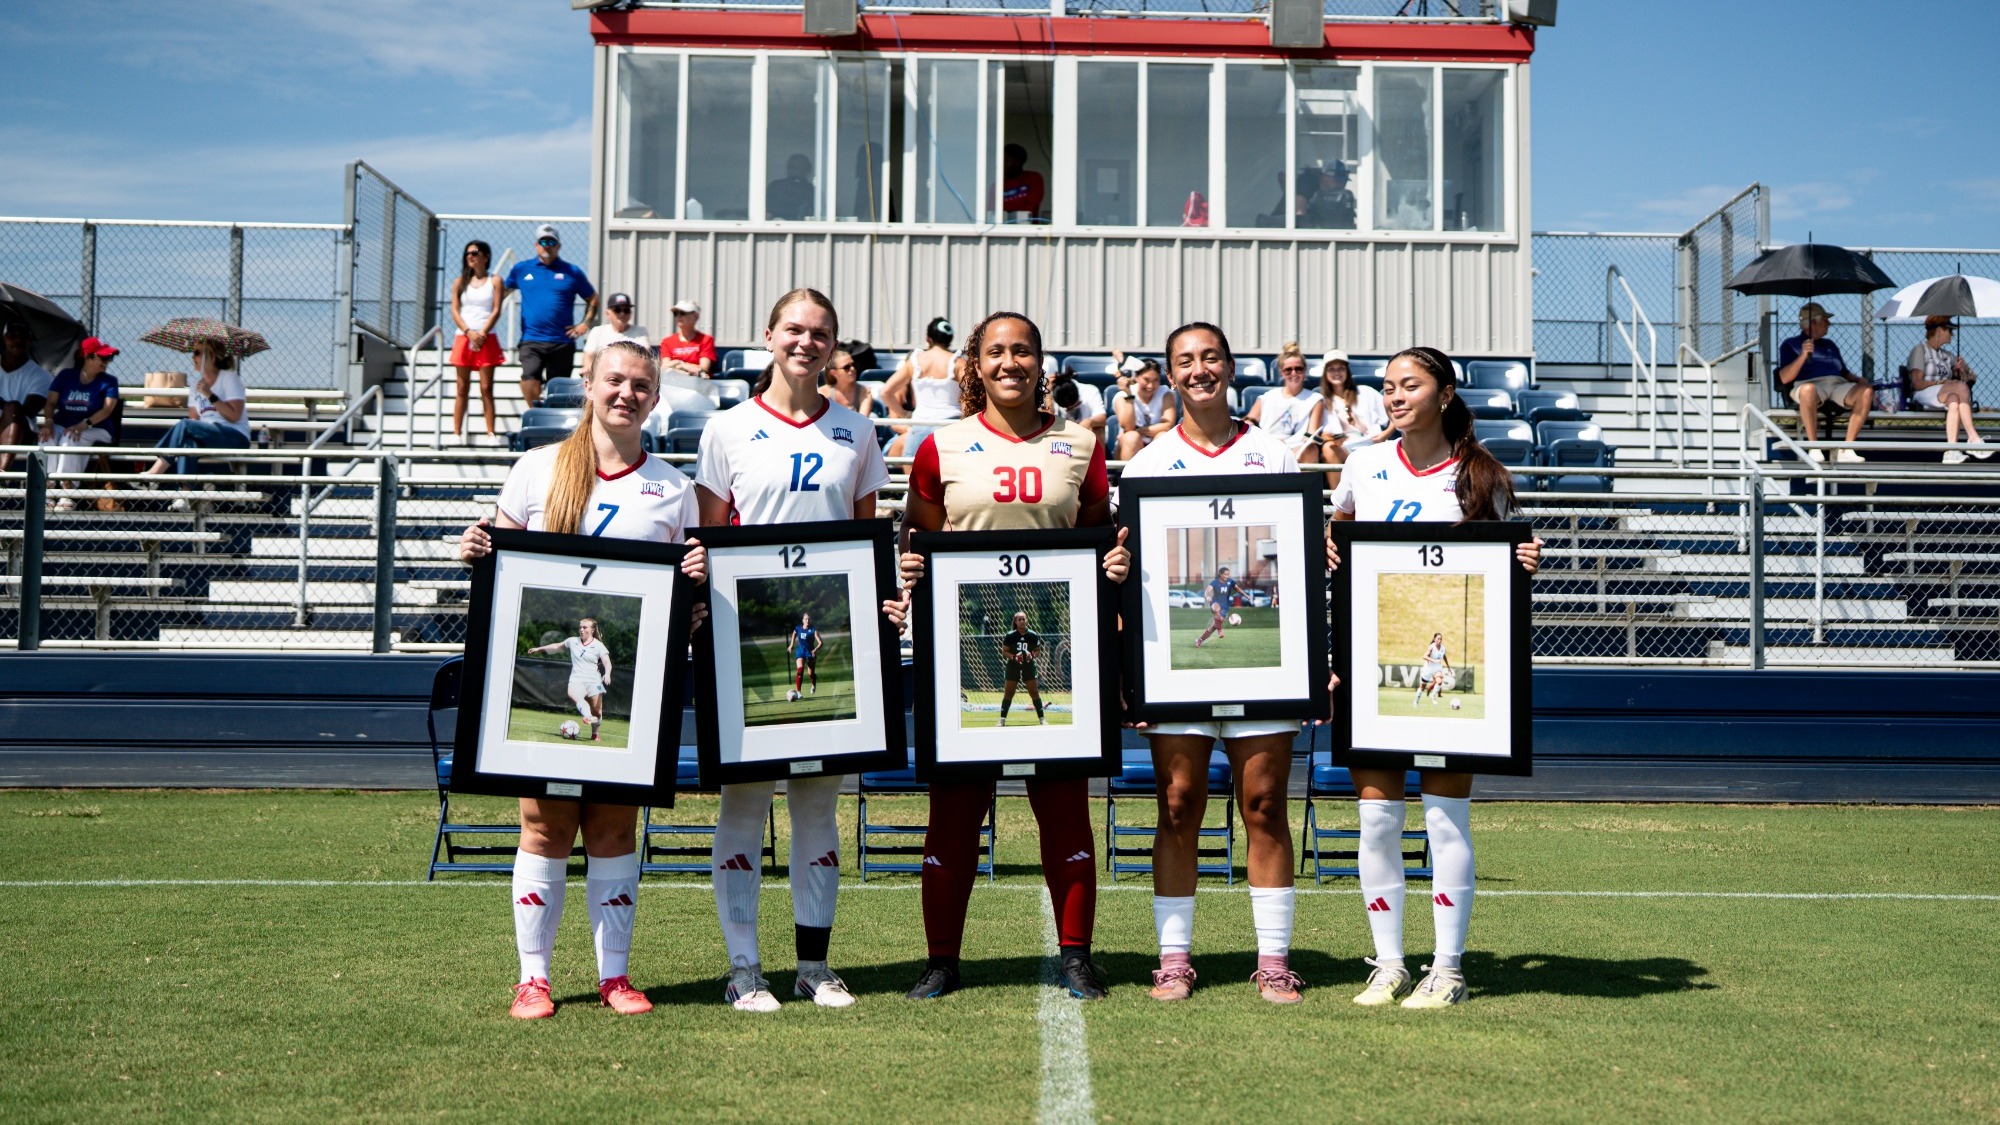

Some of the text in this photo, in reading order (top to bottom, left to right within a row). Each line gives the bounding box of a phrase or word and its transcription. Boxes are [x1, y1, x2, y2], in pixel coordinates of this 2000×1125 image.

[68, 390, 91, 401] UWG
[832, 427, 852, 439] UWG
[1051, 442, 1072, 455] UWG
[790, 452, 824, 492] 12
[642, 482, 664, 495] UWG
[993, 466, 1043, 504] 30
[591, 502, 620, 537] 7
[1208, 497, 1236, 520] 14
[778, 545, 807, 569] 12
[999, 554, 1030, 577] 30
[1418, 544, 1444, 567] 13
[580, 562, 598, 586] 7
[580, 649, 587, 658] 7
[1016, 642, 1028, 651] 30
